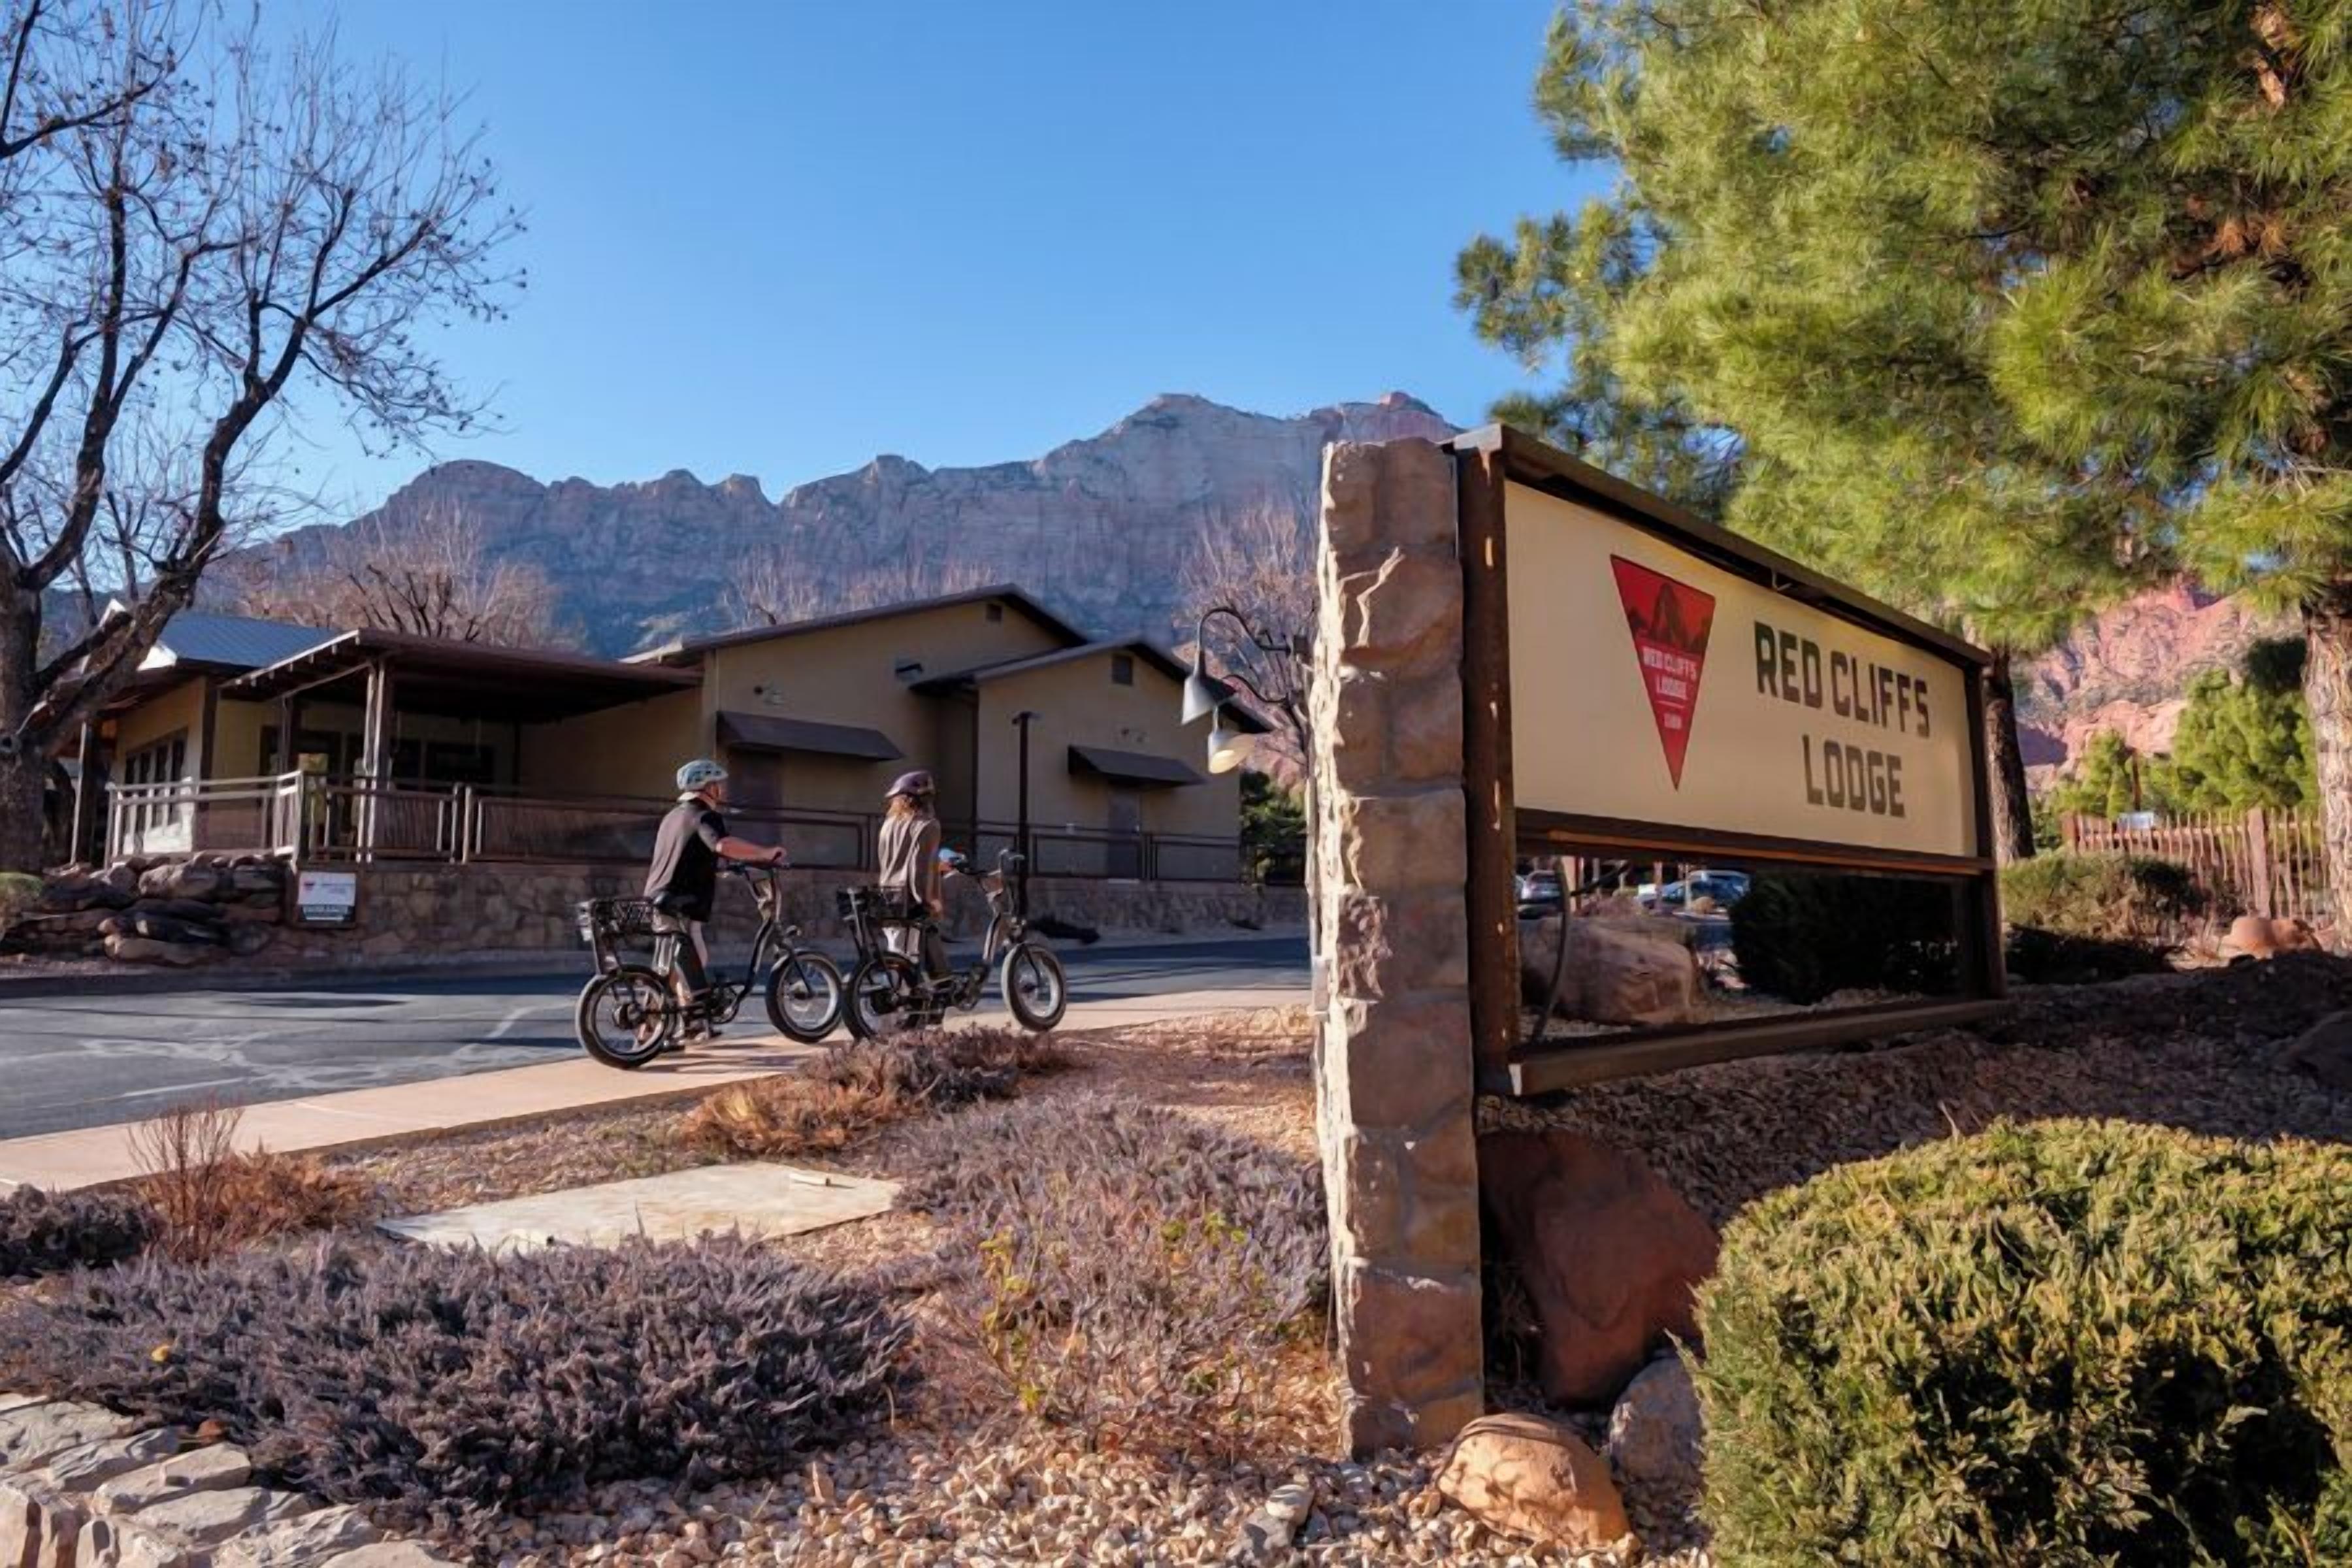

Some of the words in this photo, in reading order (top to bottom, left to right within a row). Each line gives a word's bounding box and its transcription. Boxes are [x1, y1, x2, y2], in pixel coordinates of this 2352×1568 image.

[1754, 621, 1822, 709] RED
[1831, 650, 1930, 738] CLIFFS
[1802, 734, 1906, 818] LODGE
